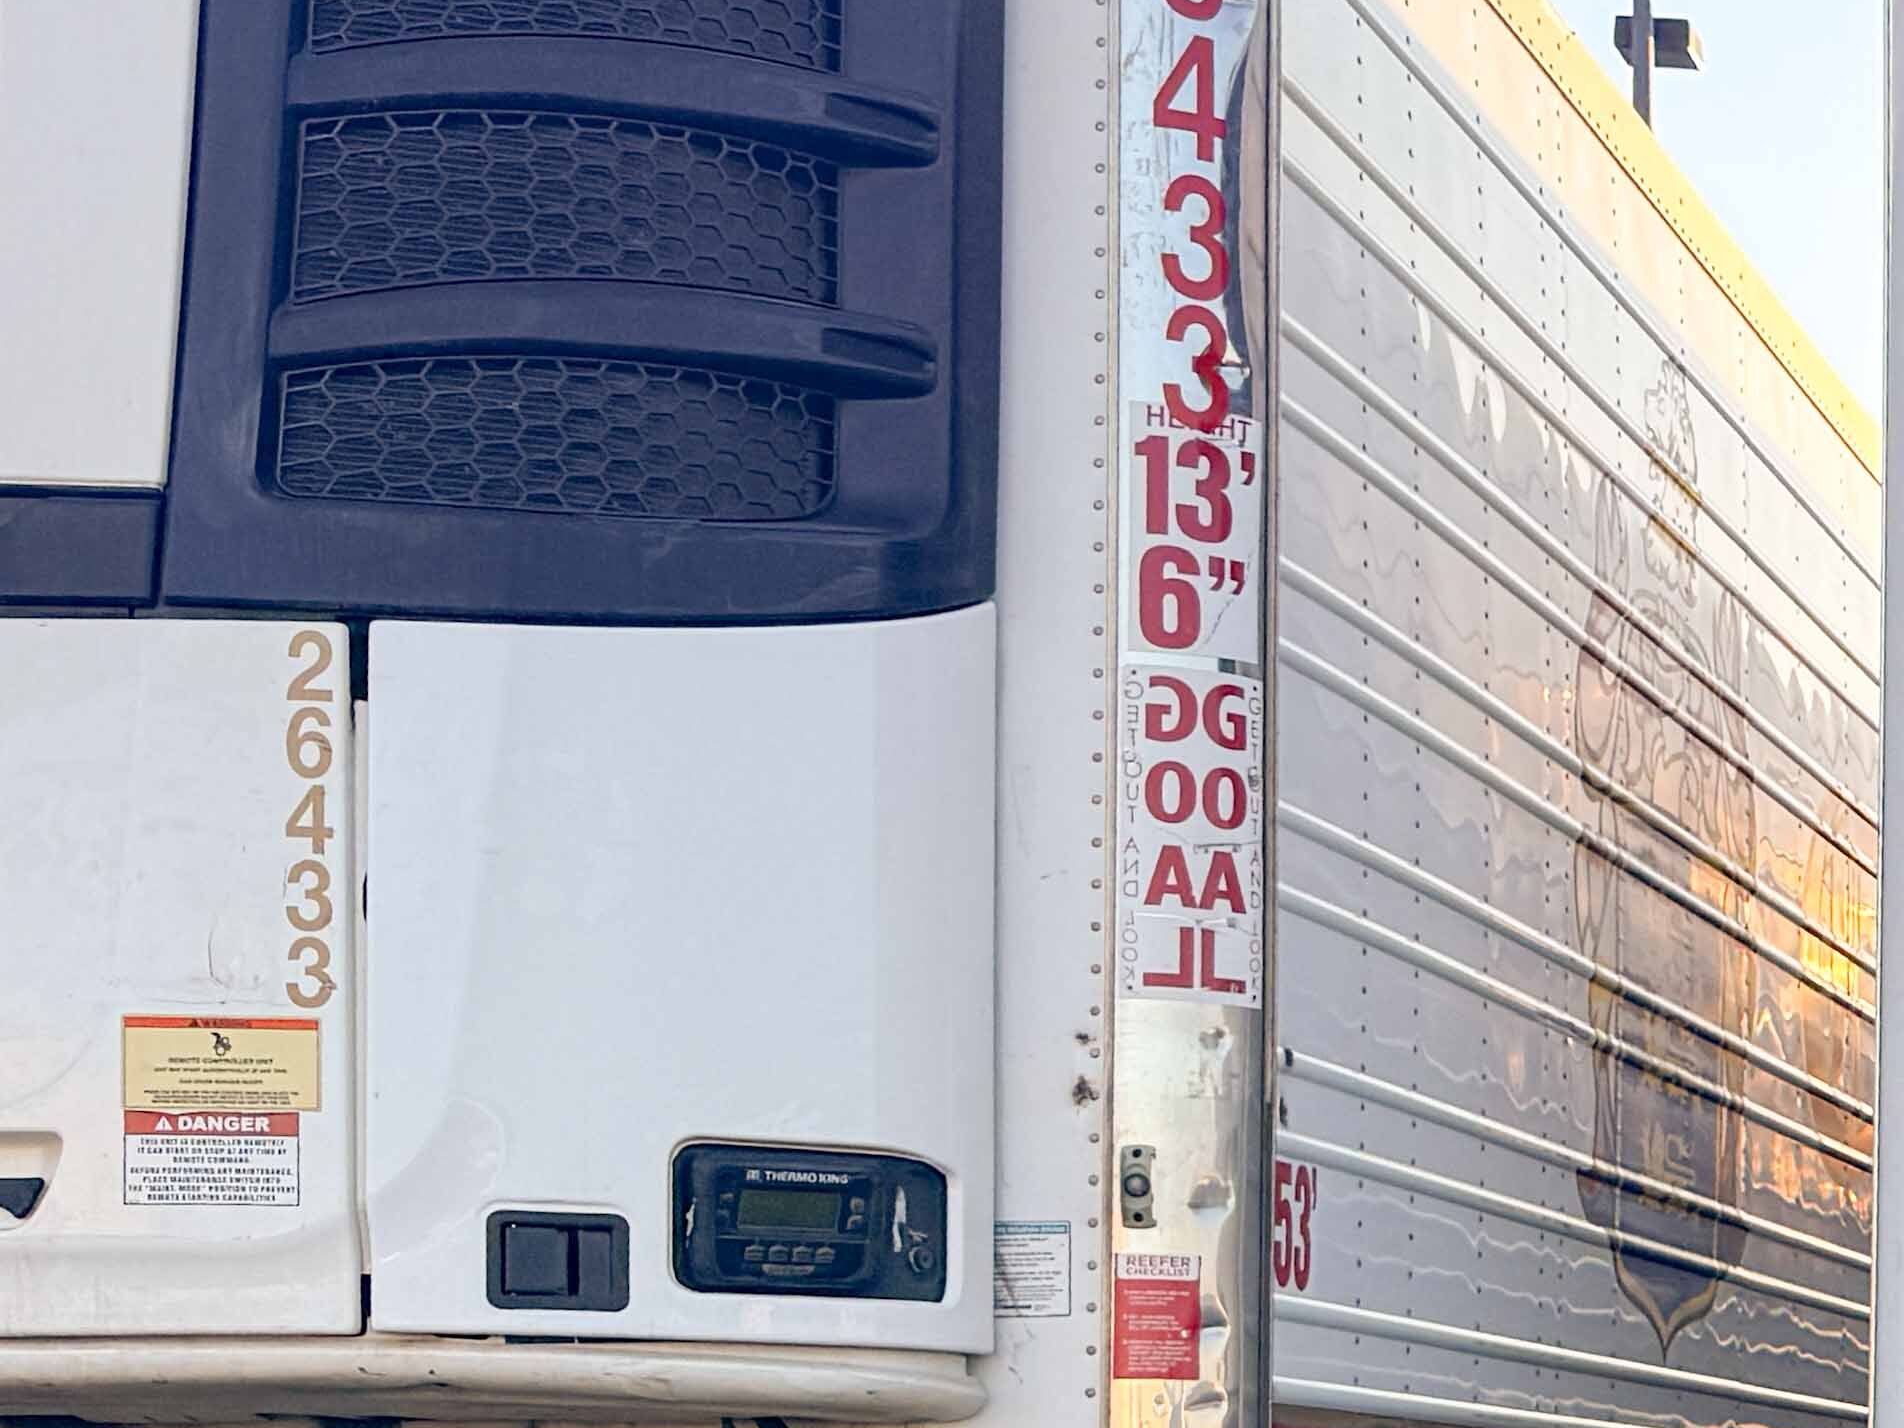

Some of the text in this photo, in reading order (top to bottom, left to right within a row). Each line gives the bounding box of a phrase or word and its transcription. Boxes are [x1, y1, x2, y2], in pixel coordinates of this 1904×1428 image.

[285, 630, 335, 1008] 26433
[1200, 684, 1247, 994] GOAL
[178, 1116, 270, 1132] DANGER
[764, 1171, 849, 1184] THERMO KING
[1274, 1160, 1317, 1291] 53'
[1126, 1254, 1191, 1268] REEFER
[1126, 1267, 1190, 1276] CHECKLIST
